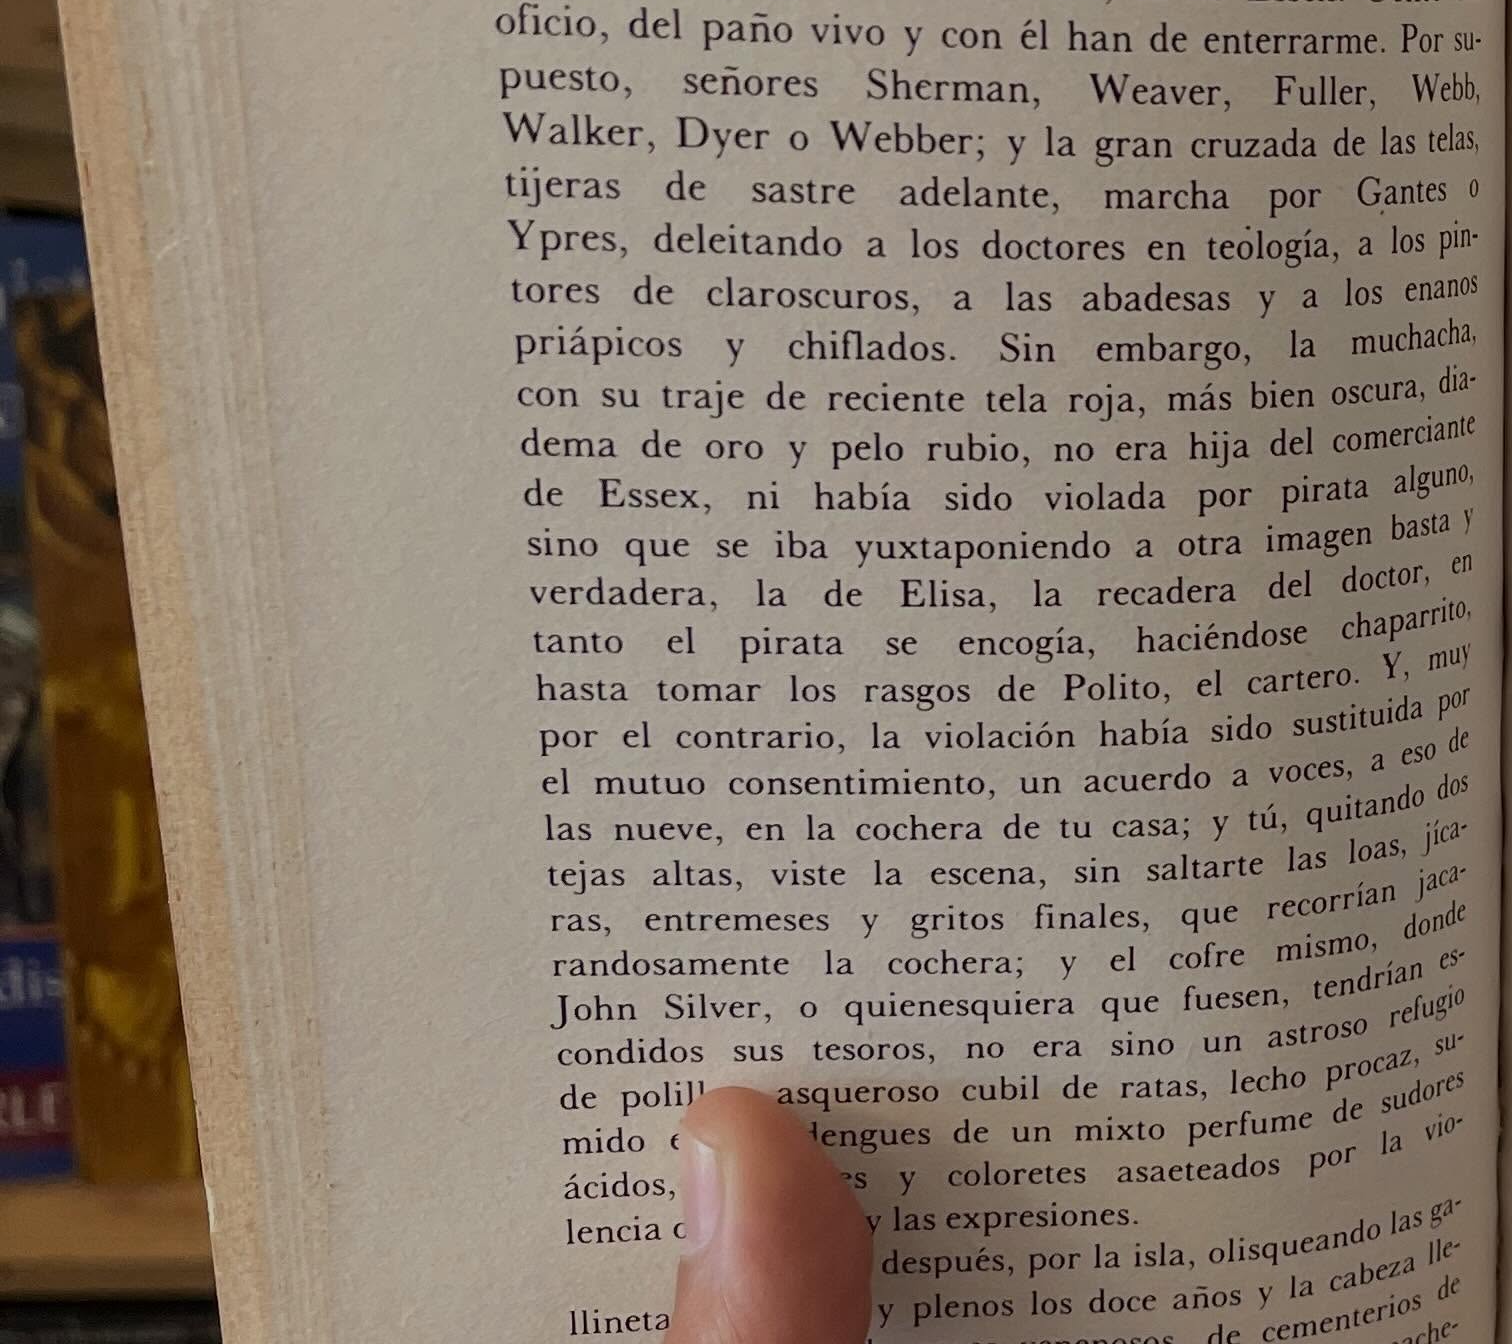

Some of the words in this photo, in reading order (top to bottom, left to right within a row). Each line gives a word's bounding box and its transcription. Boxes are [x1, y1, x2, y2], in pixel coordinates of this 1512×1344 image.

[499, 66, 633, 101] puesto,
[682, 65, 819, 98] señores
[866, 67, 1041, 111] Sherman,
[1088, 72, 1231, 113] Weaver,
[1273, 74, 1376, 112] Fuller,
[1411, 71, 1480, 105] Webb,
[514, 324, 683, 366] priápicos
[725, 338, 745, 368] y
[787, 329, 957, 362] chiflados.
[999, 331, 1057, 363] Sin
[1095, 331, 1251, 372] embargo,
[1289, 328, 1317, 359] la
[1351, 316, 1477, 356] muchacha,
[523, 477, 564, 508] de
[597, 477, 712, 516] Essex,
[746, 480, 781, 511] ni
[813, 480, 912, 512] había
[944, 481, 1013, 512] sido
[1044, 480, 1167, 512] violada
[1197, 487, 1253, 518] por
[1280, 474, 1370, 514] pirata
[1393, 463, 1474, 501] alguno,
[529, 575, 718, 613] verdadera,
[756, 578, 788, 608] la
[823, 578, 864, 608] de
[899, 578, 997, 614] Elisa,
[1032, 578, 1063, 608] la
[1097, 575, 1237, 607] recadera
[1267, 568, 1313, 600] del
[1341, 564, 1430, 594] doctor,
[1451, 553, 1473, 575] en
[538, 728, 599, 758] por
[622, 720, 652, 749] el
[675, 721, 845, 755] contrario,
[871, 721, 902, 750] la
[924, 720, 1077, 750] violación
[1098, 717, 1190, 748] había
[1210, 712, 1273, 743] sido
[1292, 694, 1424, 737] sustituida
[1437, 687, 1471, 722] por
[551, 913, 612, 937] ras,
[644, 910, 830, 932] entremeses
[860, 913, 880, 940] y
[910, 904, 1005, 940] gritos
[1034, 902, 1150, 934] finales,
[1180, 904, 1239, 935] que
[1266, 879, 1397, 921] recorrían
[1414, 864, 1467, 904] jaca-
[549, 993, 638, 1031] John
[664, 992, 772, 1025] Silver,
[799, 1000, 818, 1019] o
[844, 989, 1075, 1027] quienesquiera
[1101, 995, 1160, 1023] que
[1183, 984, 1289, 1012] fuesen,
[1312, 959, 1424, 1001] tendrían
[1439, 948, 1466, 971] es-
[881, 1245, 1015, 1280] después,
[1028, 1251, 1082, 1280] por
[1093, 1243, 1121, 1270] la
[1133, 1241, 1196, 1271] isla,
[1208, 1218, 1382, 1267] olisqueando
[1390, 1209, 1423, 1236] las
[1429, 1198, 1462, 1230] ga-
